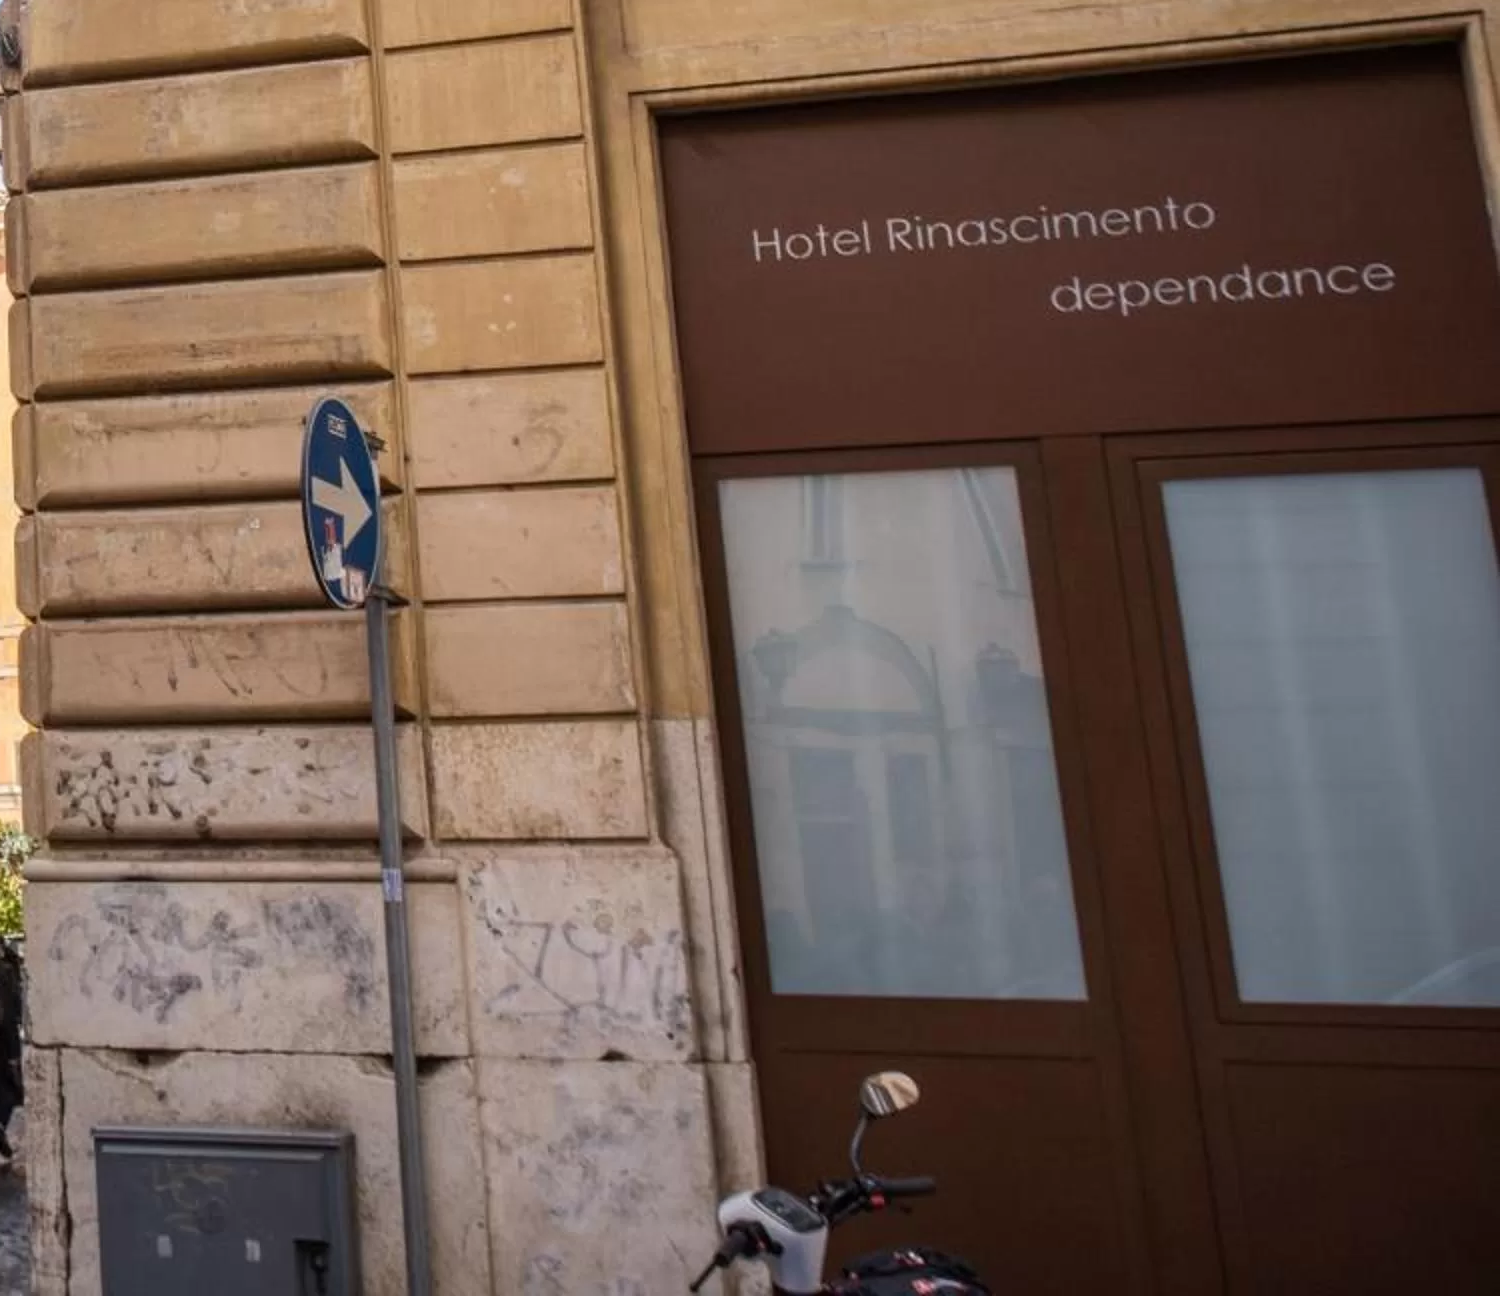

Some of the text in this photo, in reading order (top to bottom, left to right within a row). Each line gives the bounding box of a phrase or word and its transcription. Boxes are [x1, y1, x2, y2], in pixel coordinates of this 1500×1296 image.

[752, 196, 1216, 262] Hotel Rinascimento
[1050, 261, 1396, 317] dependance
